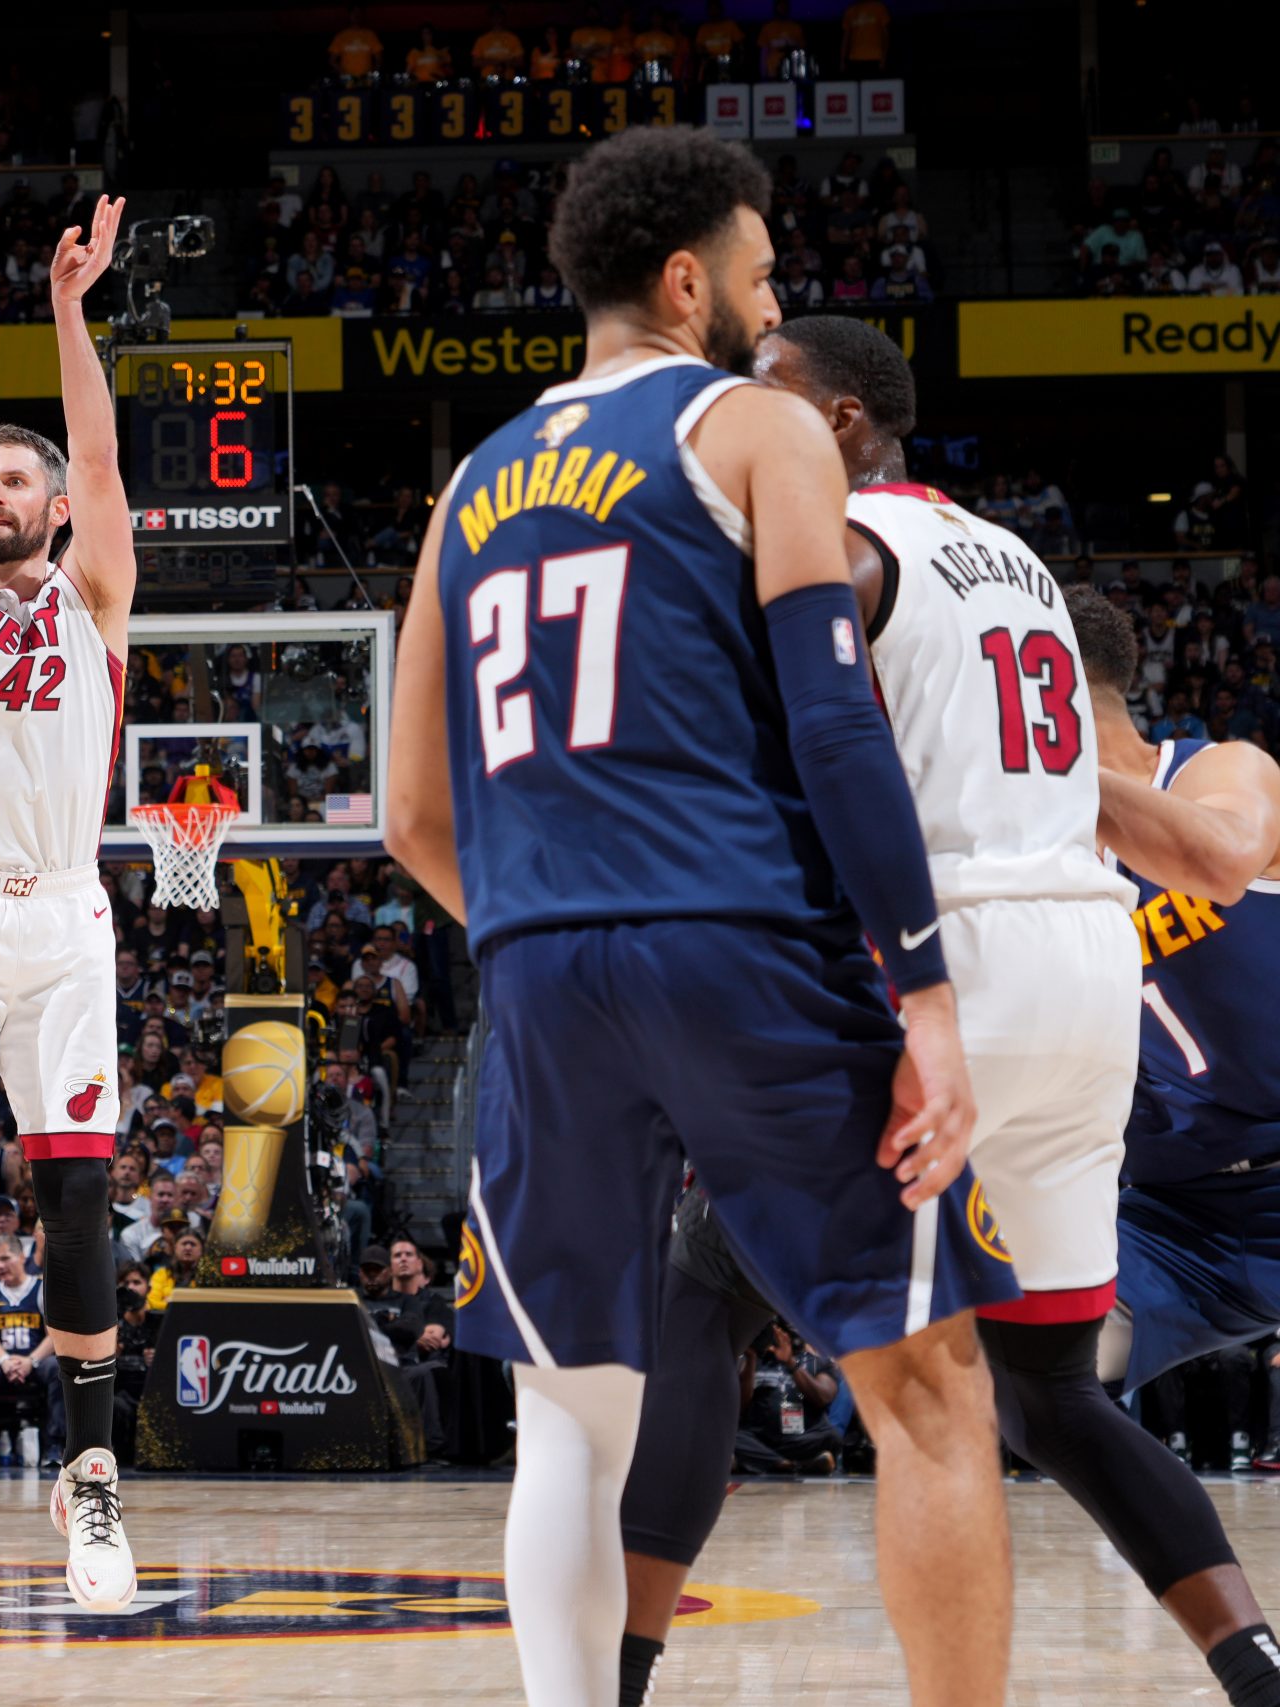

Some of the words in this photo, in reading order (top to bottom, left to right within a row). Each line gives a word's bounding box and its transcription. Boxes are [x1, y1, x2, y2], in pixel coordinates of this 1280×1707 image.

[289, 97, 315, 143] 3
[337, 96, 362, 142] 3
[390, 95, 415, 141] 3
[440, 93, 466, 139] 3
[498, 91, 524, 137] 3
[547, 89, 573, 135] 3
[372, 325, 584, 377] Wester
[1123, 309, 1280, 363] Ready
[172, 361, 265, 405] 7:32
[210, 411, 253, 488] 6
[167, 506, 282, 529] TISSOT
[458, 446, 647, 555] MURRAY
[930, 542, 1053, 609] ADEBAYO
[467, 542, 631, 779] 27
[979, 626, 1083, 776] 13
[1130, 889, 1226, 966] VER
[1142, 980, 1208, 1076] 1
[192, 1340, 357, 1414] Finals
[89, 1462, 107, 1475] XL
